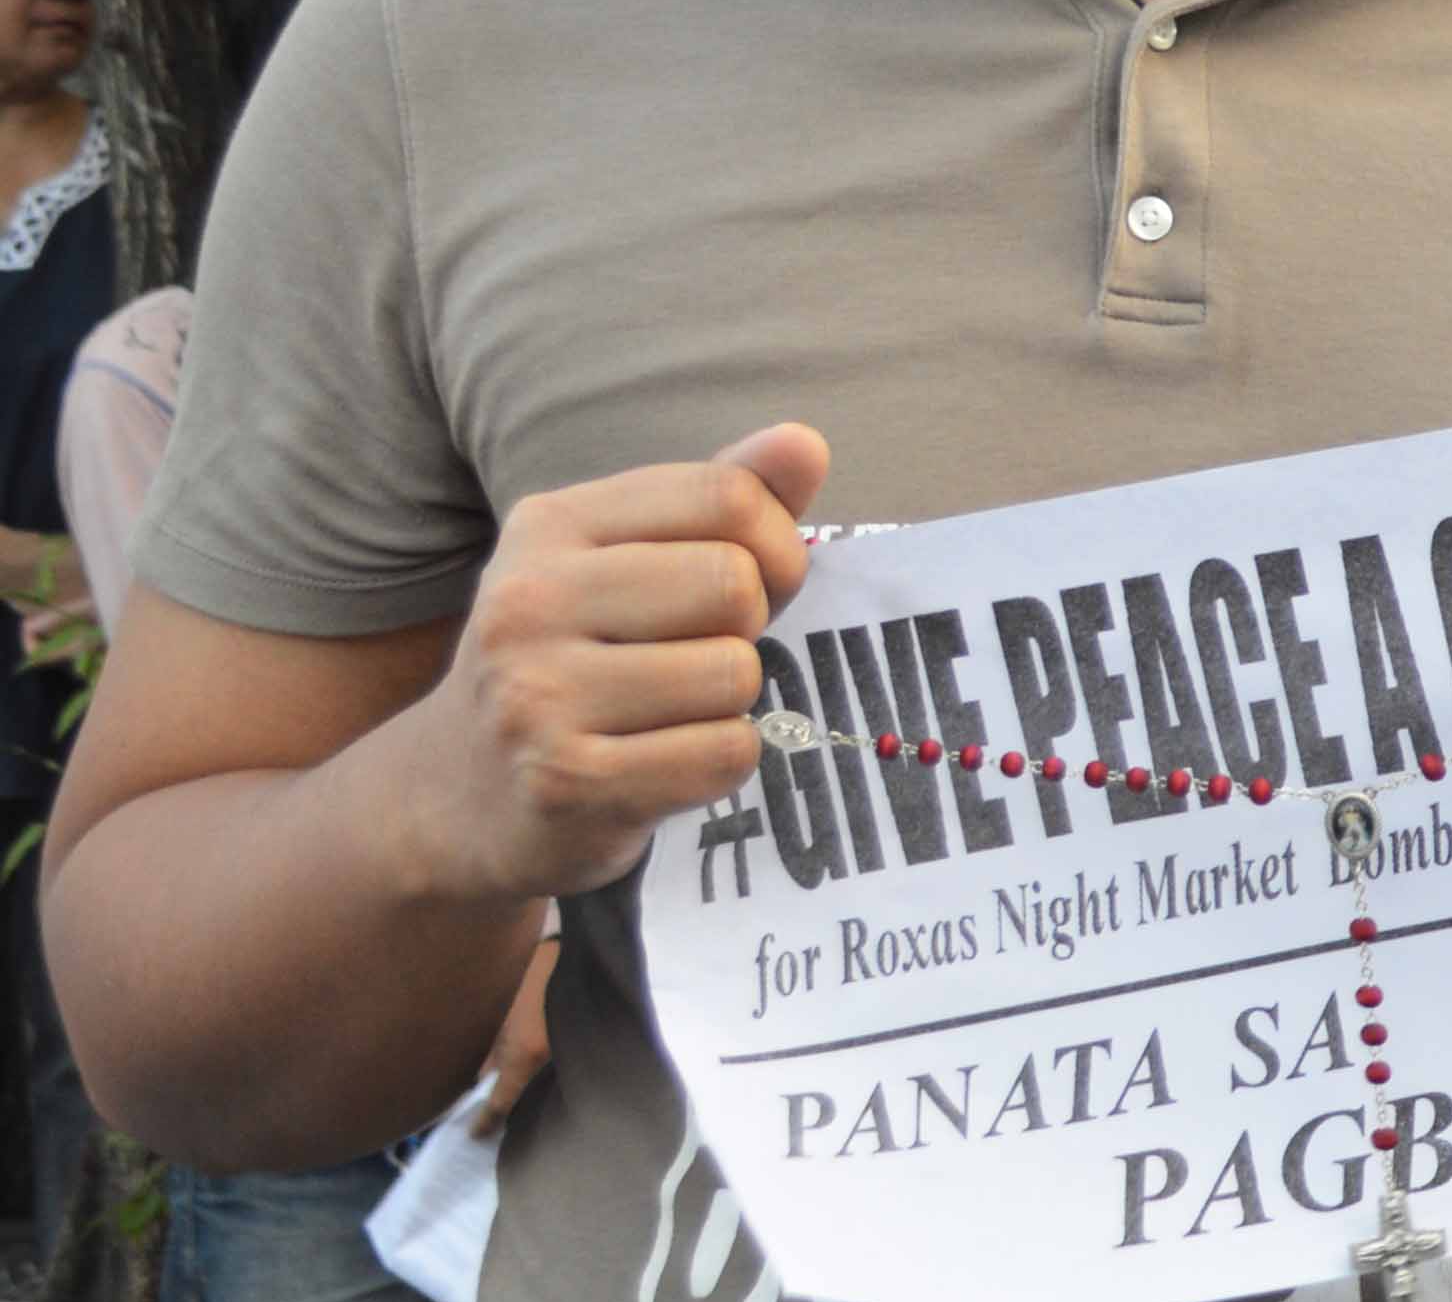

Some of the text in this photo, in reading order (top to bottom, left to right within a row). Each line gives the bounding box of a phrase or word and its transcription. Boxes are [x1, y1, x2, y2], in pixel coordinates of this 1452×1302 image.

[992, 545, 1356, 840] PEACE
[1337, 532, 1450, 776] A
[752, 930, 823, 1018] for
[838, 906, 979, 989] Roxas
[994, 869, 1122, 970] Night
[1135, 837, 1298, 923] Market
[782, 989, 1354, 1162] PANATA SA
